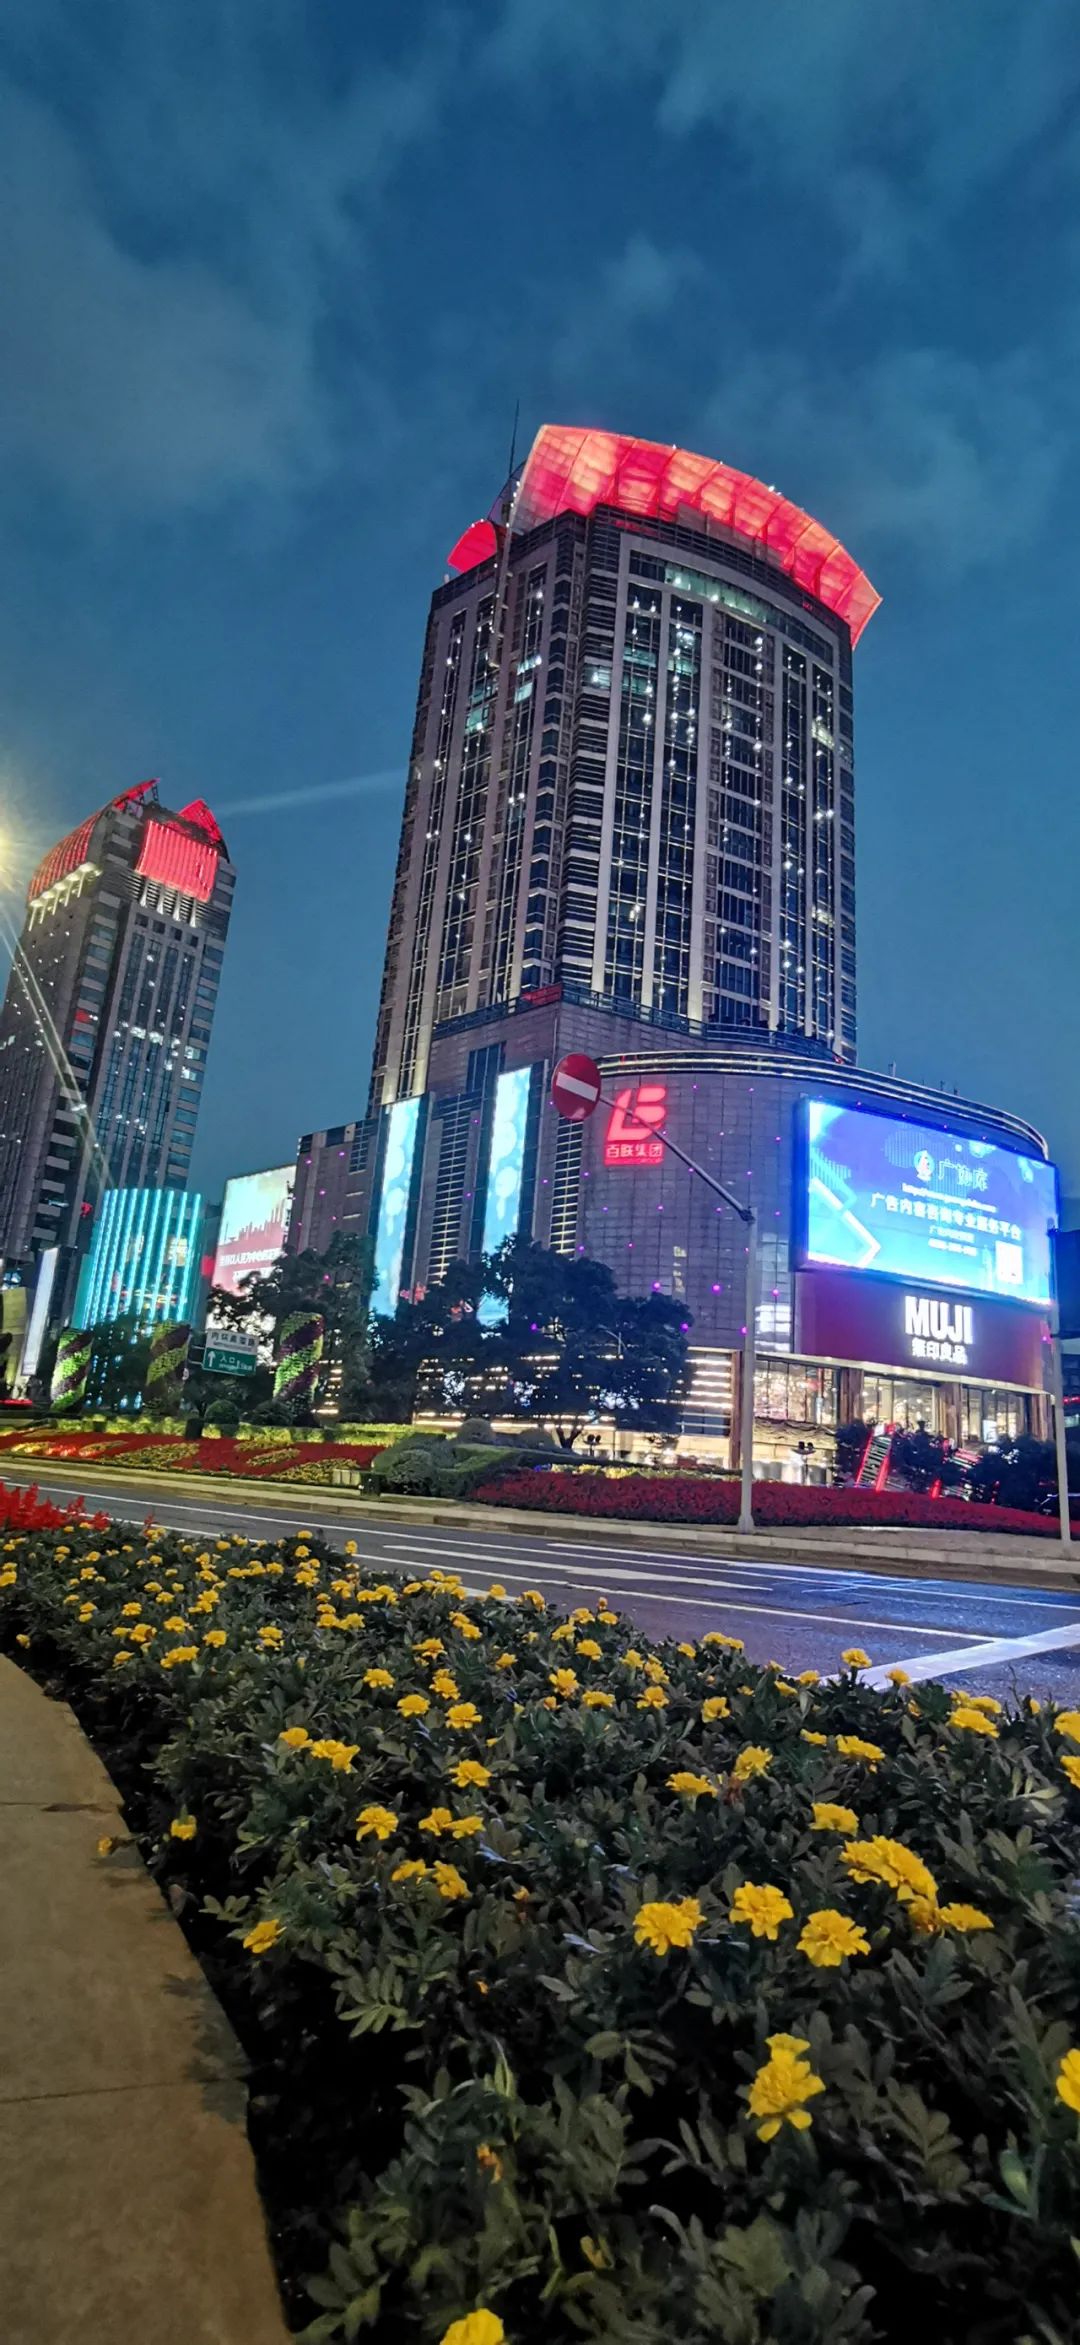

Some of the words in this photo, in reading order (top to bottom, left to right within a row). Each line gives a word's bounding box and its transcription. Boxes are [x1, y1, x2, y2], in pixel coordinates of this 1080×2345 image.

[606, 1143, 663, 1158] 百联集团
[904, 1295, 974, 1345] MUJI
